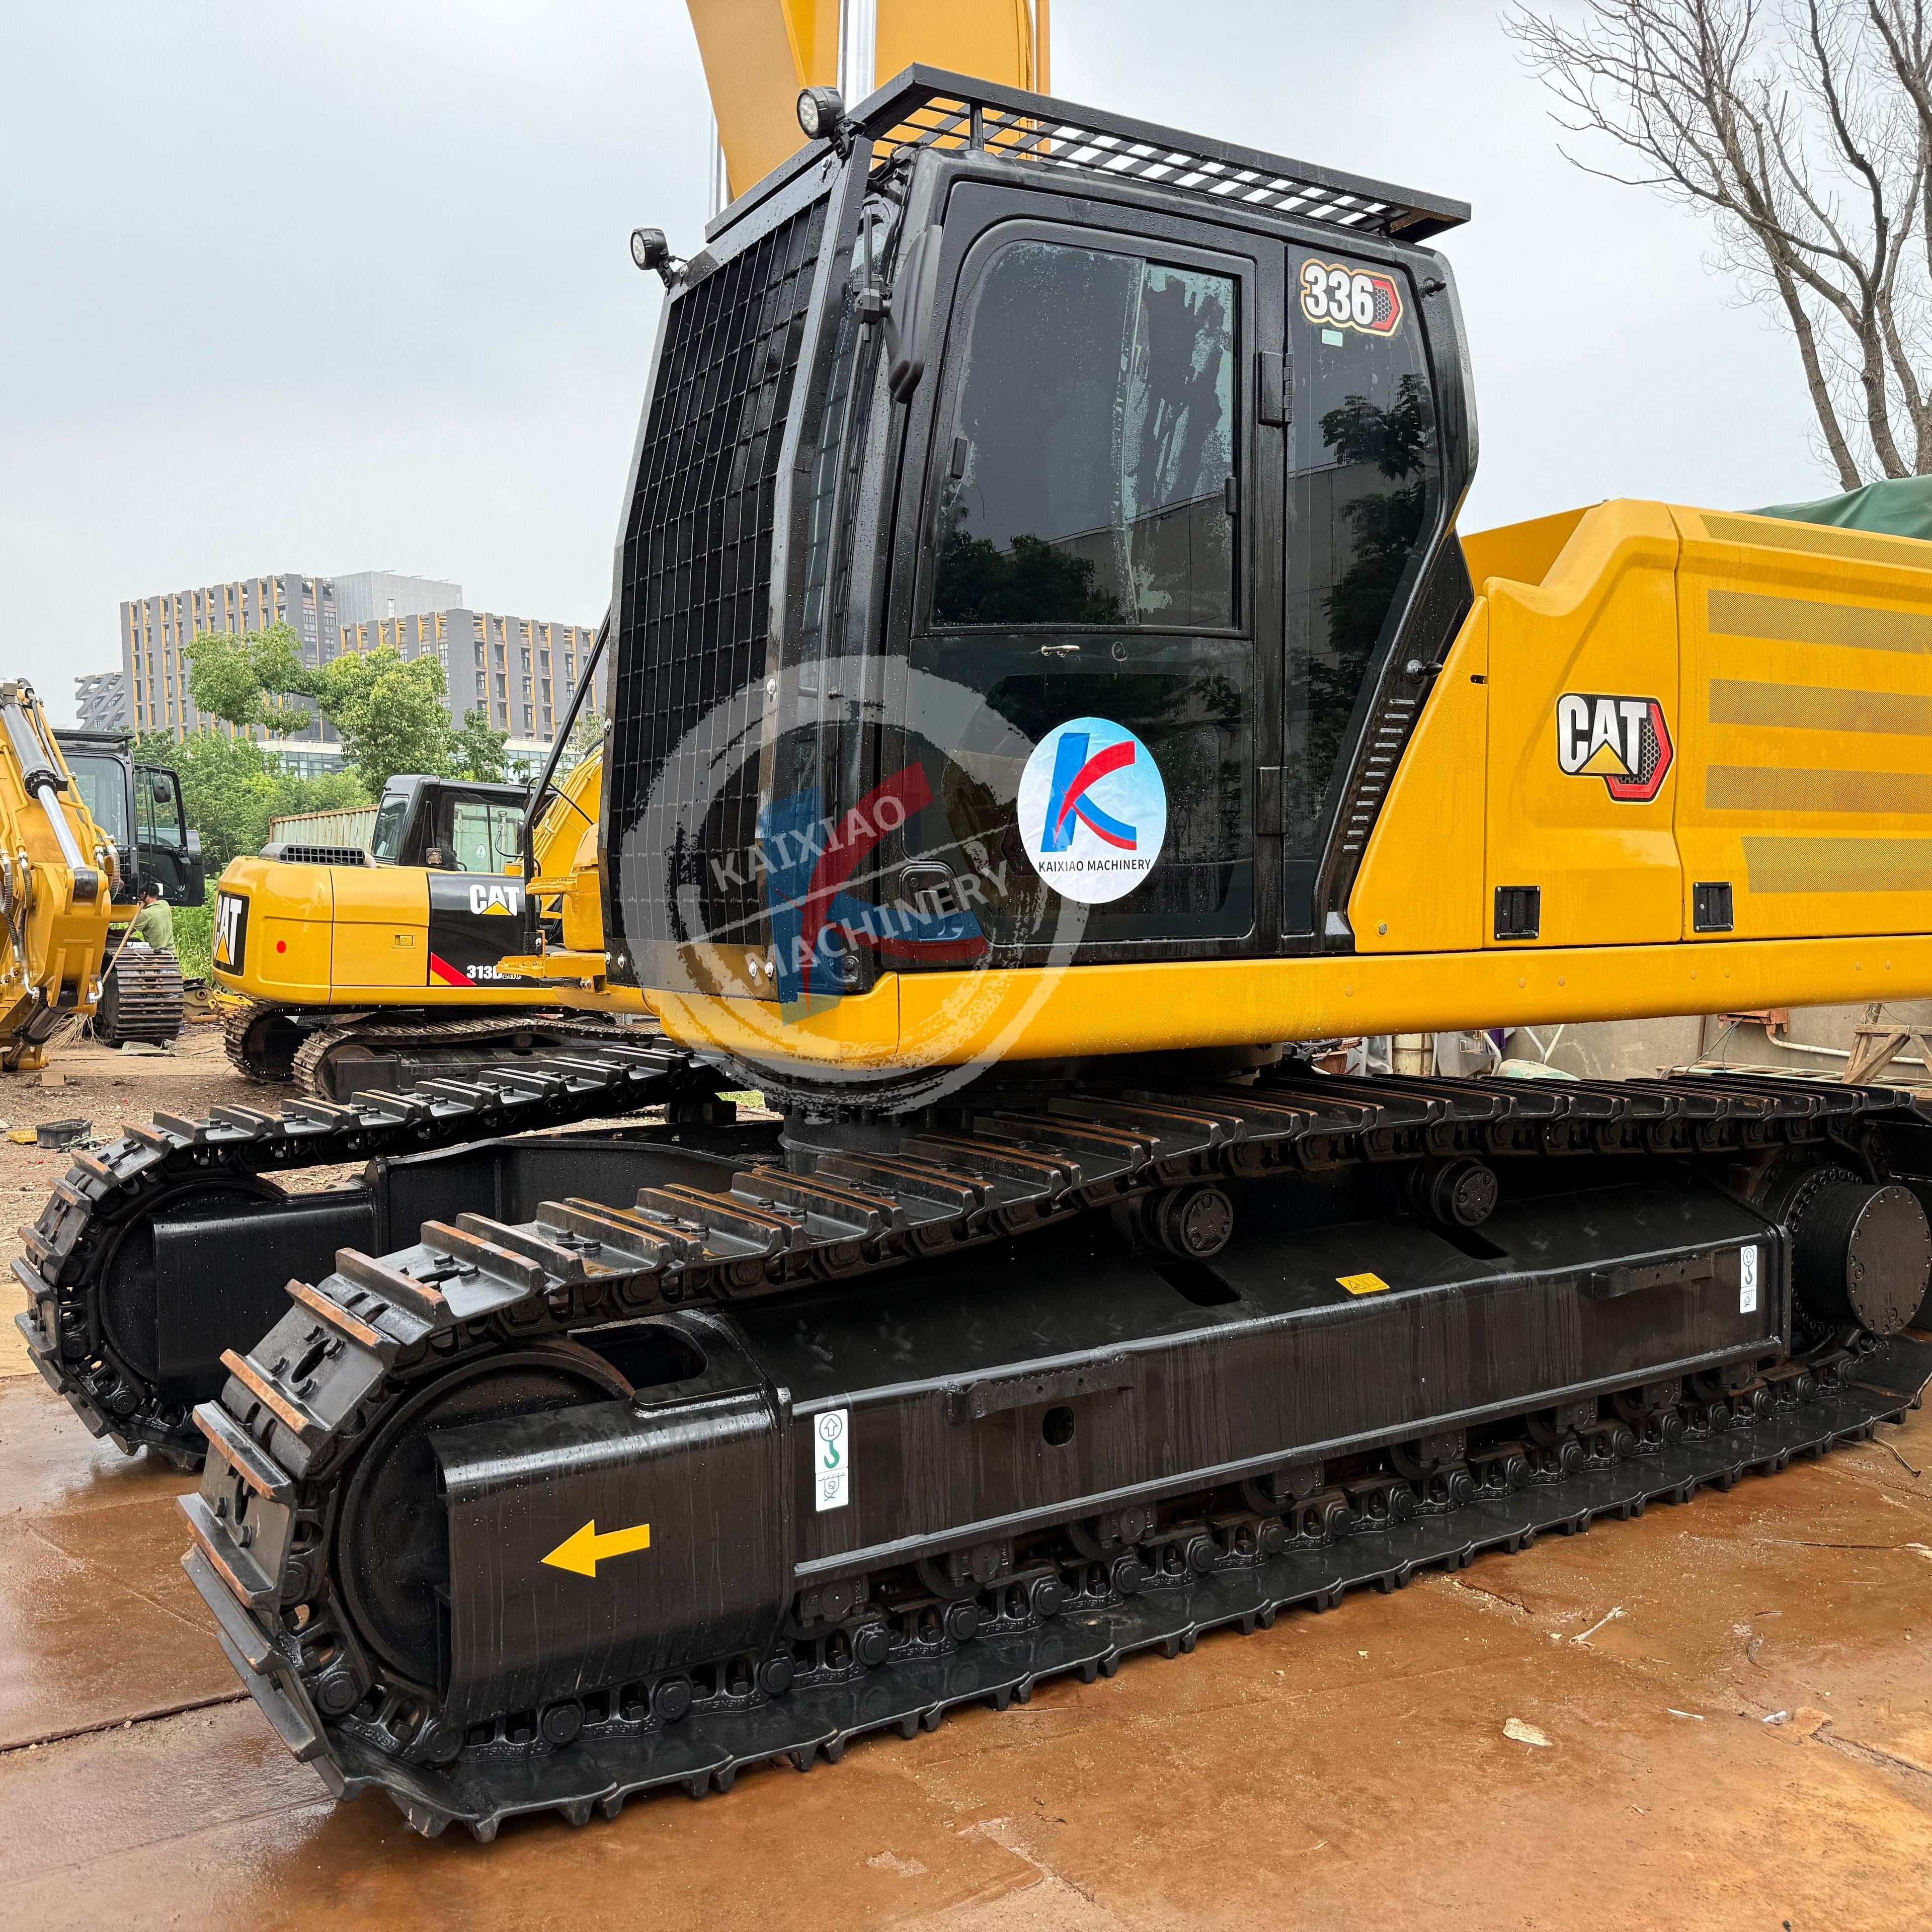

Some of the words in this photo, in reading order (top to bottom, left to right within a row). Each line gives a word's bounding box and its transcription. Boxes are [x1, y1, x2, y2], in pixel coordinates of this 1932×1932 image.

[1305, 265, 1374, 325] 336
[1558, 695, 1647, 775] CAT
[1038, 860, 1084, 872] KAIXIAO
[1087, 859, 1151, 871] MACHINERY
[213, 894, 243, 966] CAT
[469, 884, 520, 916] CAT
